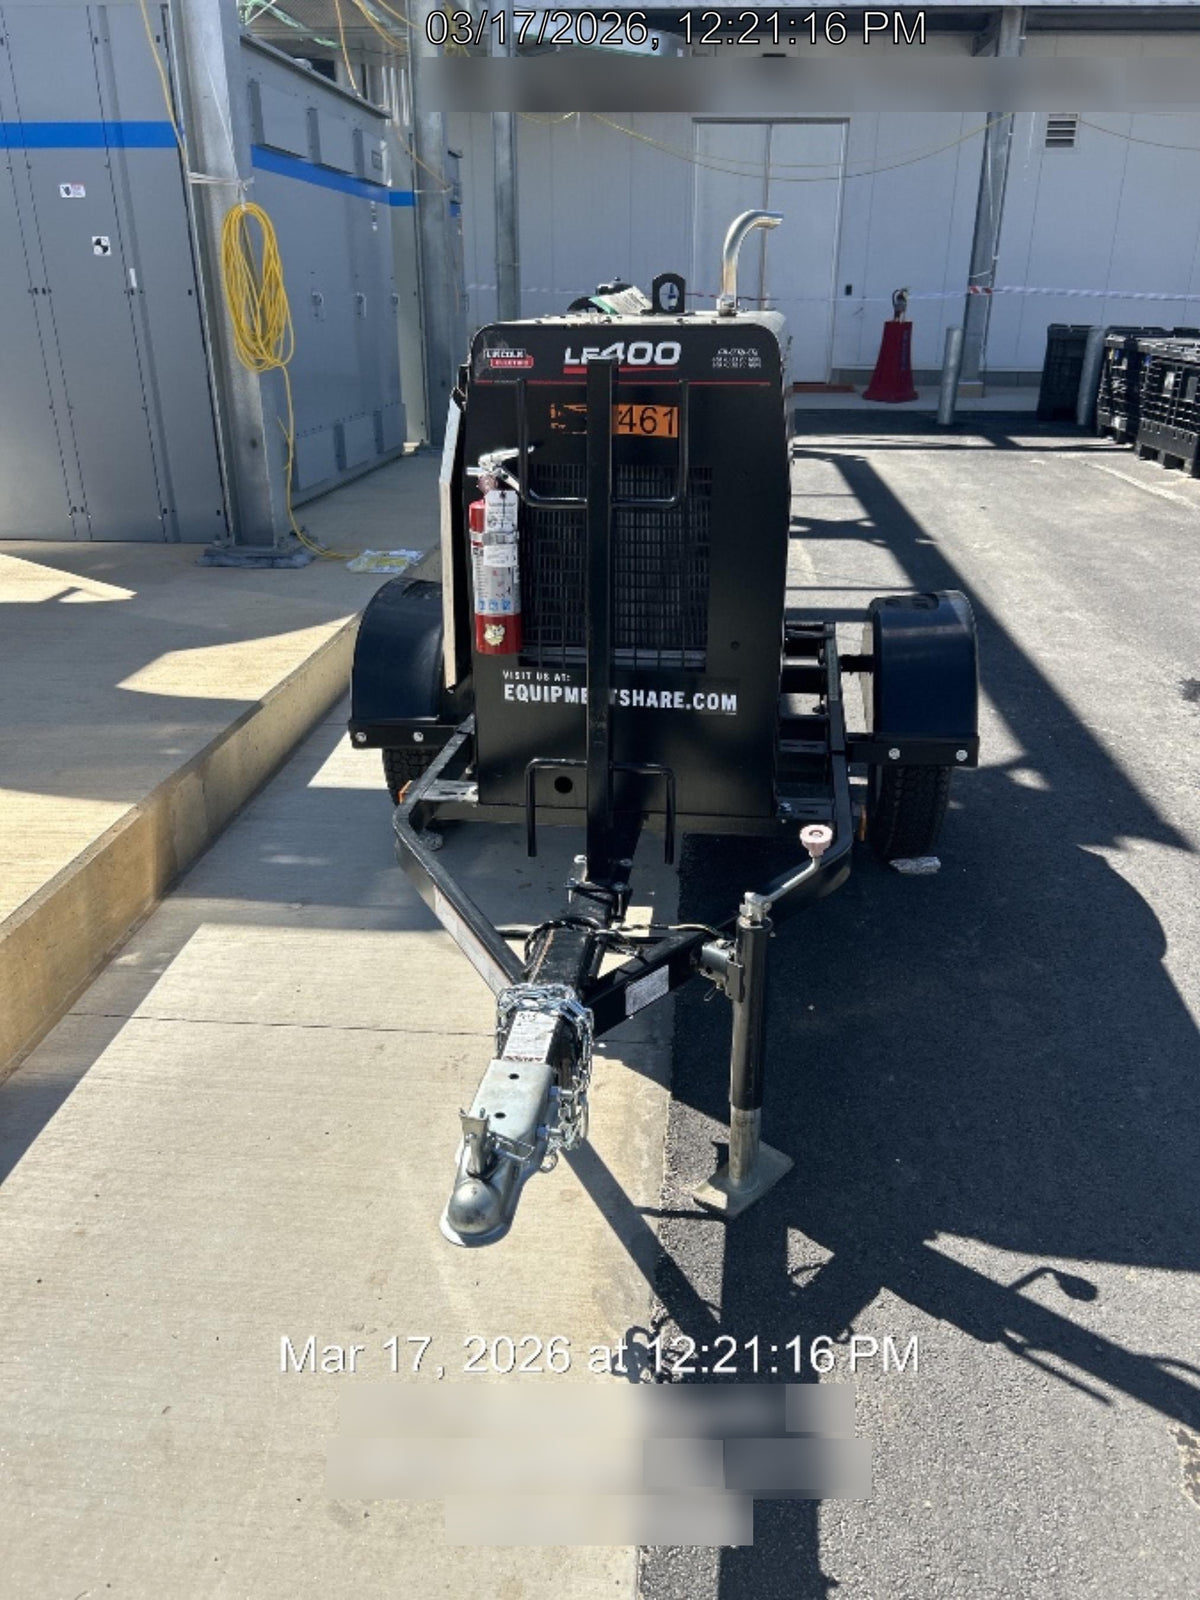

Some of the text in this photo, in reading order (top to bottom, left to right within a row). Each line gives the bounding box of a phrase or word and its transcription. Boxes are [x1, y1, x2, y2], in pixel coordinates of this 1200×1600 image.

[502, 669, 571, 682] VISIT US AT:
[503, 683, 738, 712] EQUIPMETSHARE.COM
